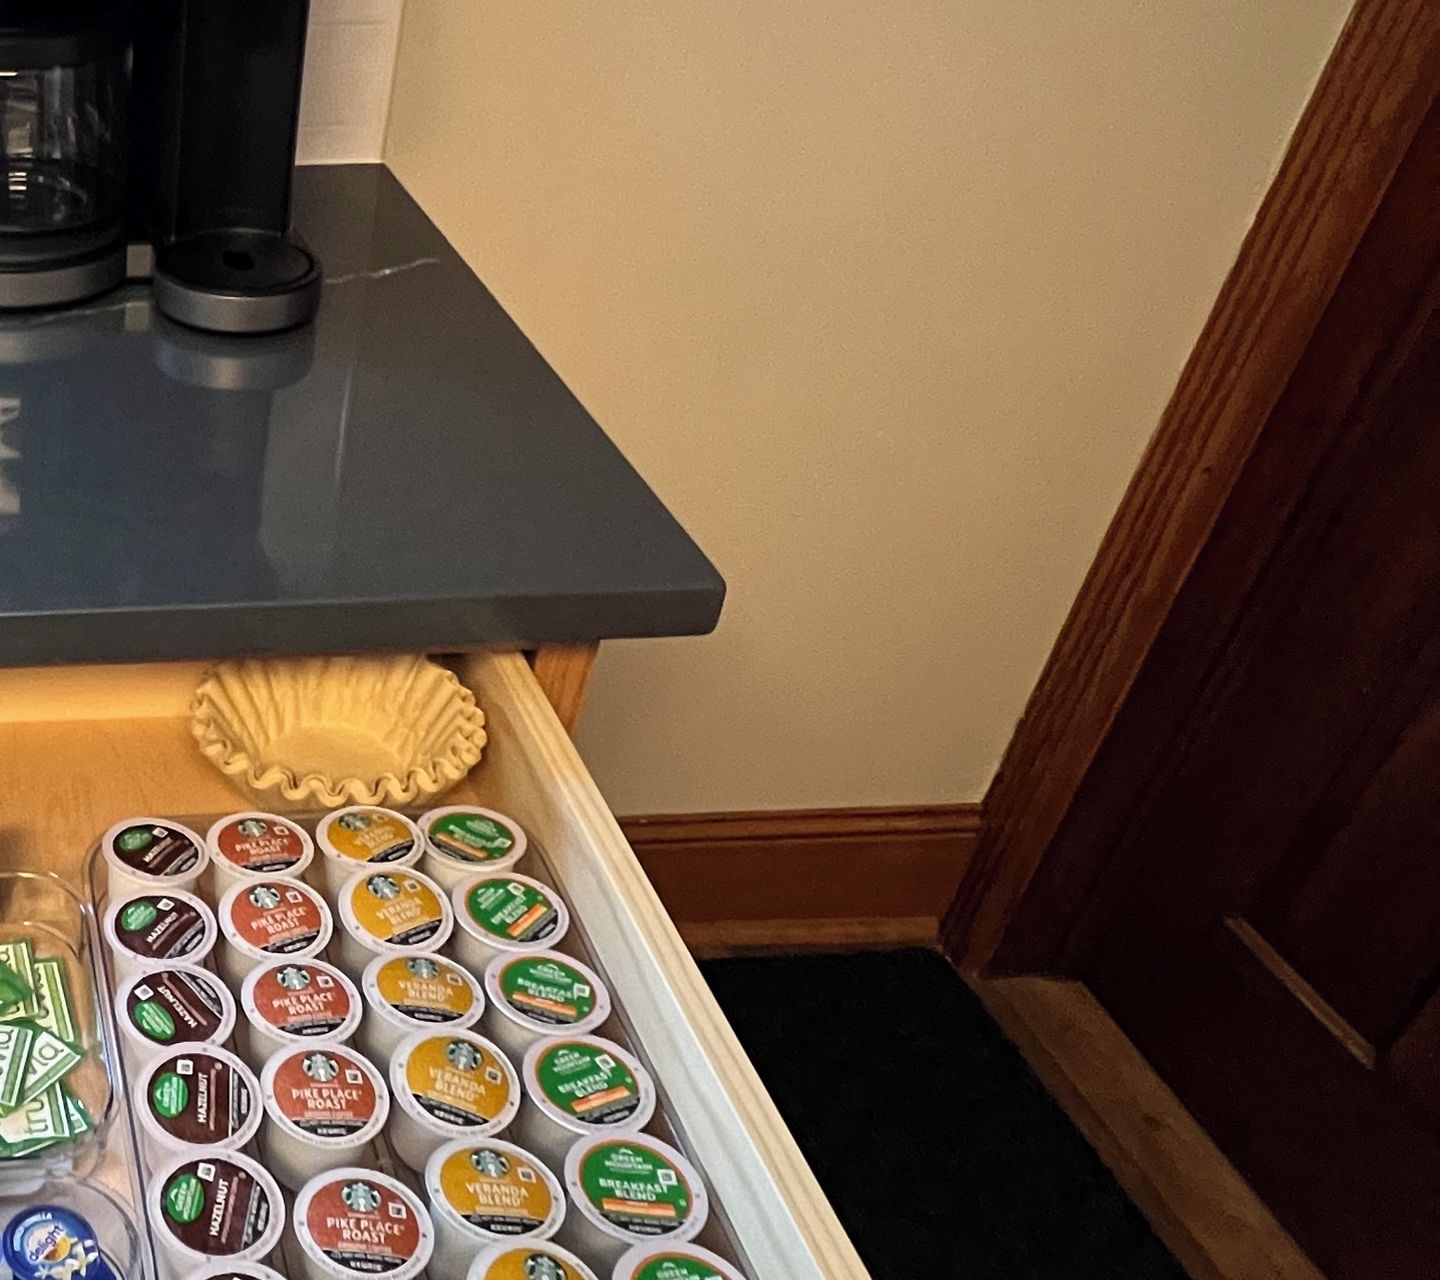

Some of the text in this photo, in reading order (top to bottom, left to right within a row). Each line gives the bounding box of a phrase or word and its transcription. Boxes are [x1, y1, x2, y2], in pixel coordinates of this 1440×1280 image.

[251, 907, 307, 930] PIKE PLACE
[266, 920, 300, 934] ROAST
[398, 980, 454, 996] VERANDA
[157, 984, 198, 1029] HAZELNUT
[272, 991, 334, 1009] PIKE PLACE
[288, 1002, 325, 1015] ROAST
[429, 1067, 486, 1095] VERANDA
[197, 1072, 209, 1123] HAZELNUT
[291, 1088, 360, 1100] PIKE PLACE
[435, 1079, 475, 1100] BLEND
[307, 1098, 347, 1110] ROAST
[465, 1182, 529, 1198] VERANDA
[598, 1178, 668, 1194] BREAKFAST
[479, 1192, 521, 1206] BLEND
[615, 1189, 656, 1201] BLEND
[209, 1178, 229, 1236] HAZELNUT
[326, 1216, 402, 1236] PIKE PLACE
[28, 1225, 64, 1262] delight
[342, 1228, 386, 1244] ROAST
